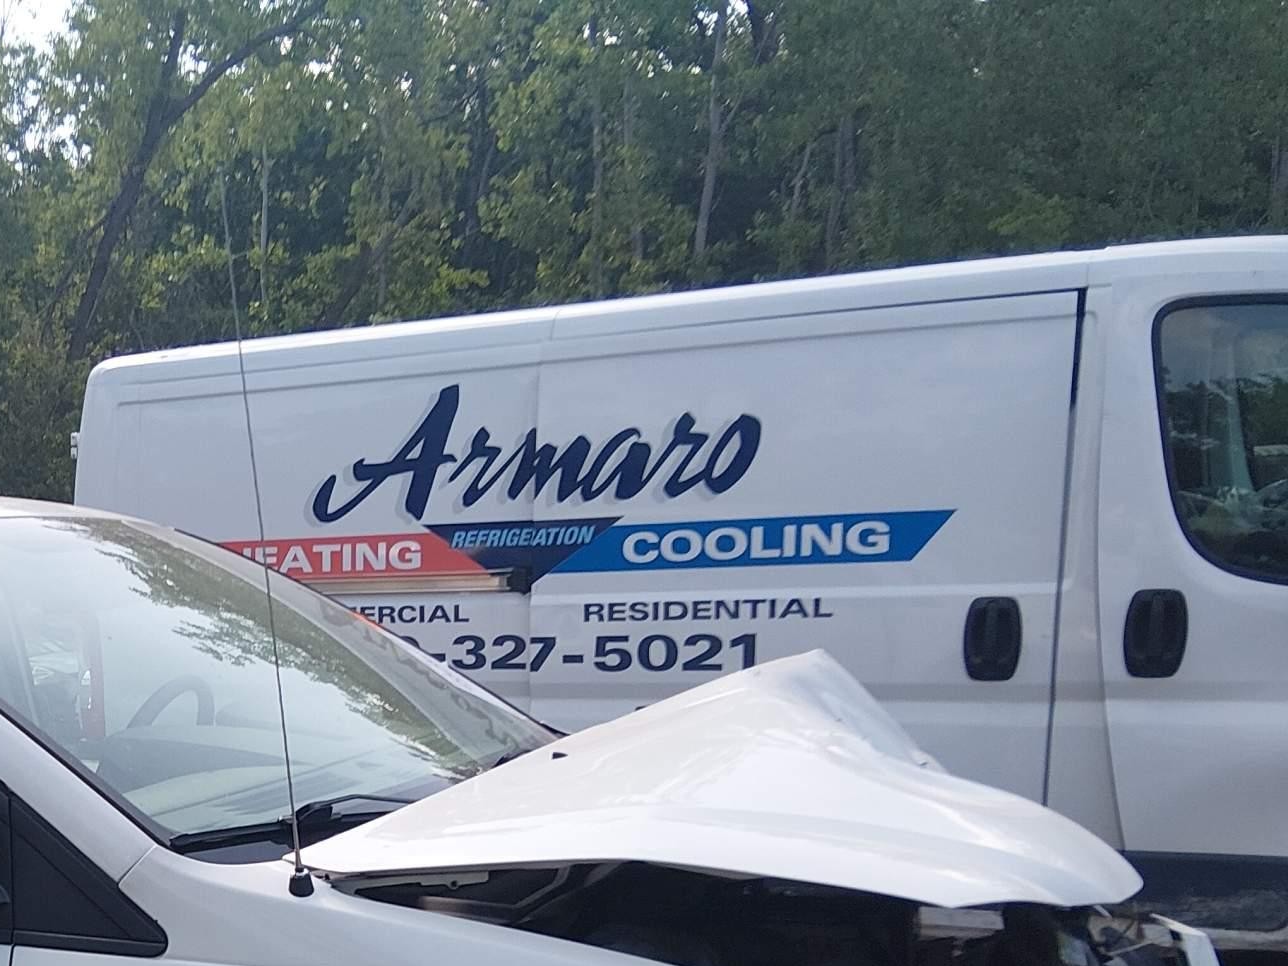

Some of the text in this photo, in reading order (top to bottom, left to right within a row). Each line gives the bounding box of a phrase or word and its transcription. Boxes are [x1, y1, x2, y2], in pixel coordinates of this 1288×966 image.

[312, 383, 762, 523] Armaro
[451, 525, 596, 549] REFRIGEATION
[622, 520, 891, 564] COOLING
[352, 597, 834, 624] ERCIAL RESIDENTIAL
